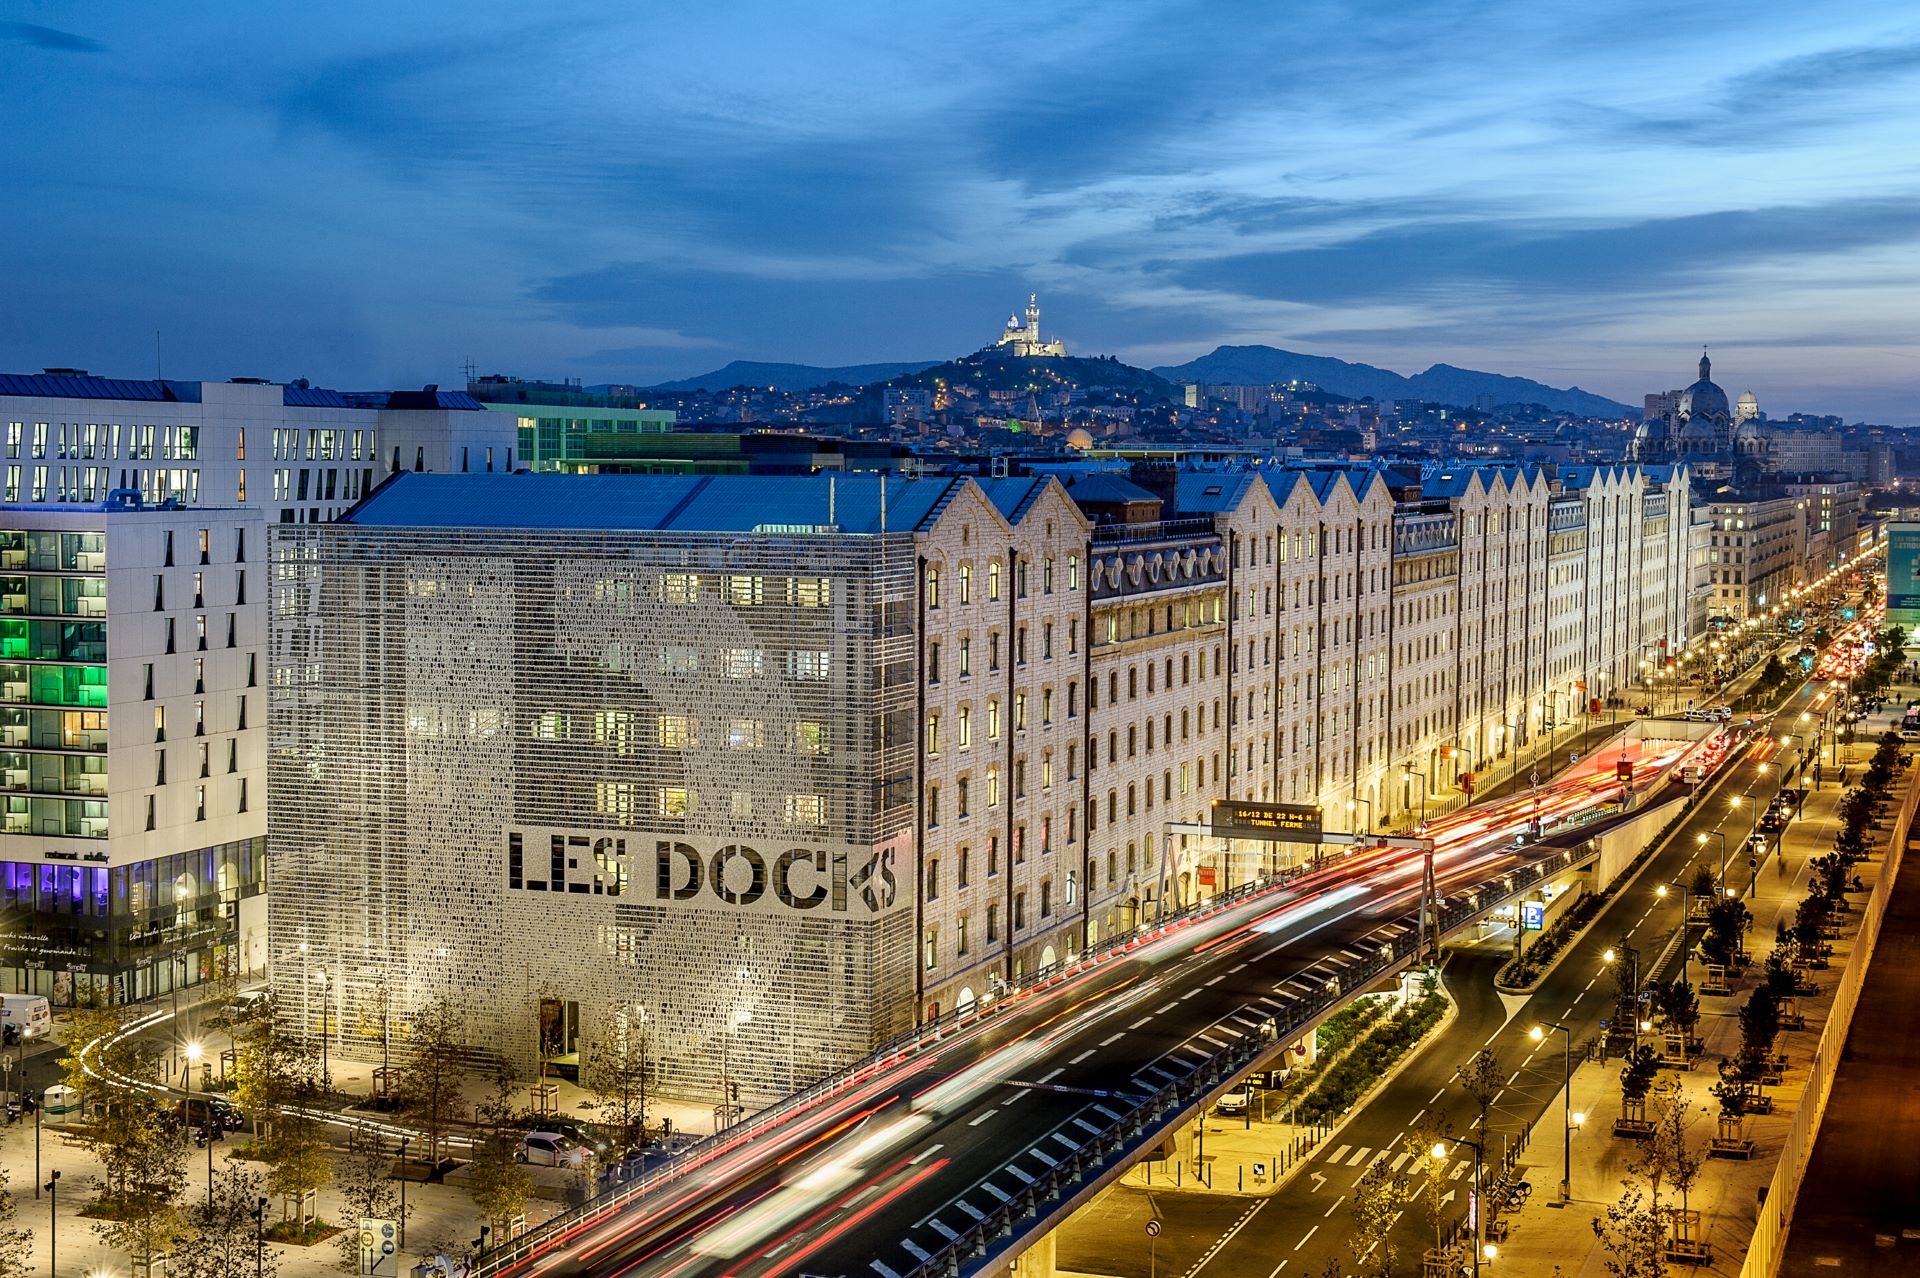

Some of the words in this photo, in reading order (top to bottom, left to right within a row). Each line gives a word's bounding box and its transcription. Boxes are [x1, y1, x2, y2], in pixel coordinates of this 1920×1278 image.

[1238, 810, 1261, 818] 16/12
[1276, 812, 1286, 820] 22
[1251, 819, 1277, 828] TUNNEL
[1280, 821, 1303, 829] FERME
[508, 832, 628, 897] LES
[655, 840, 897, 913] DOCKS
[39, 947, 76, 956] gourmande
